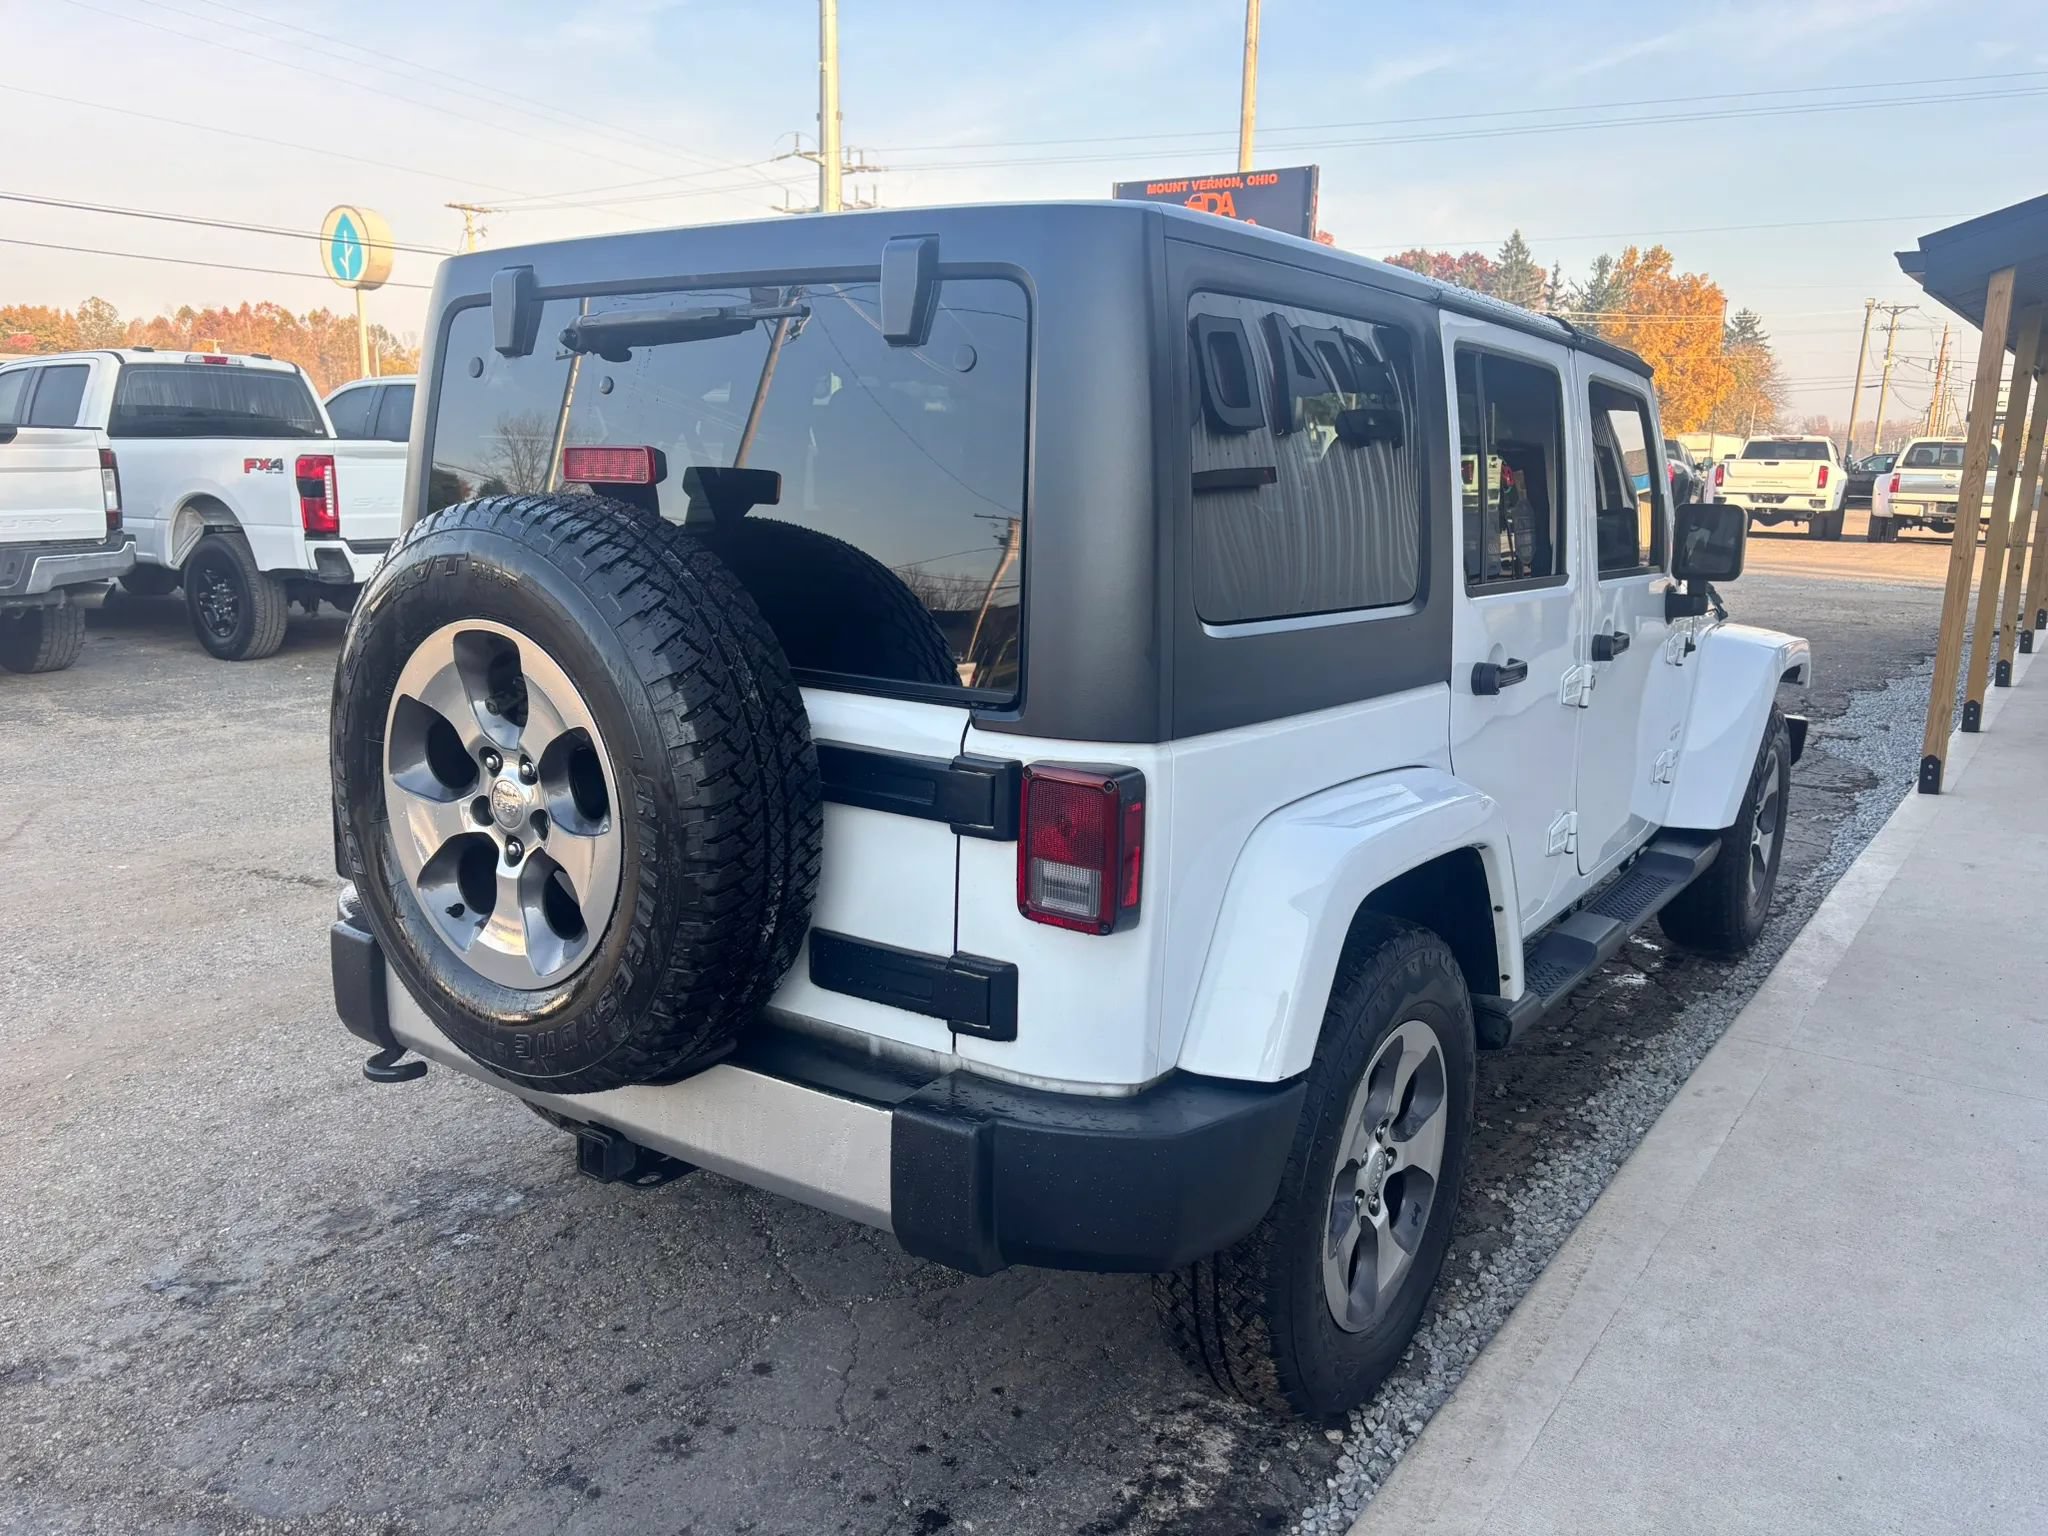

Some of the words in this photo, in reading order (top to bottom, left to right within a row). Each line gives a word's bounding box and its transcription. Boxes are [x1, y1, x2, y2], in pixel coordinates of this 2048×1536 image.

[1147, 181, 1188, 194] MOUNT
[1191, 176, 1244, 192] VERNON,
[1247, 174, 1278, 186] OHIO
[243, 457, 284, 474] FX4
